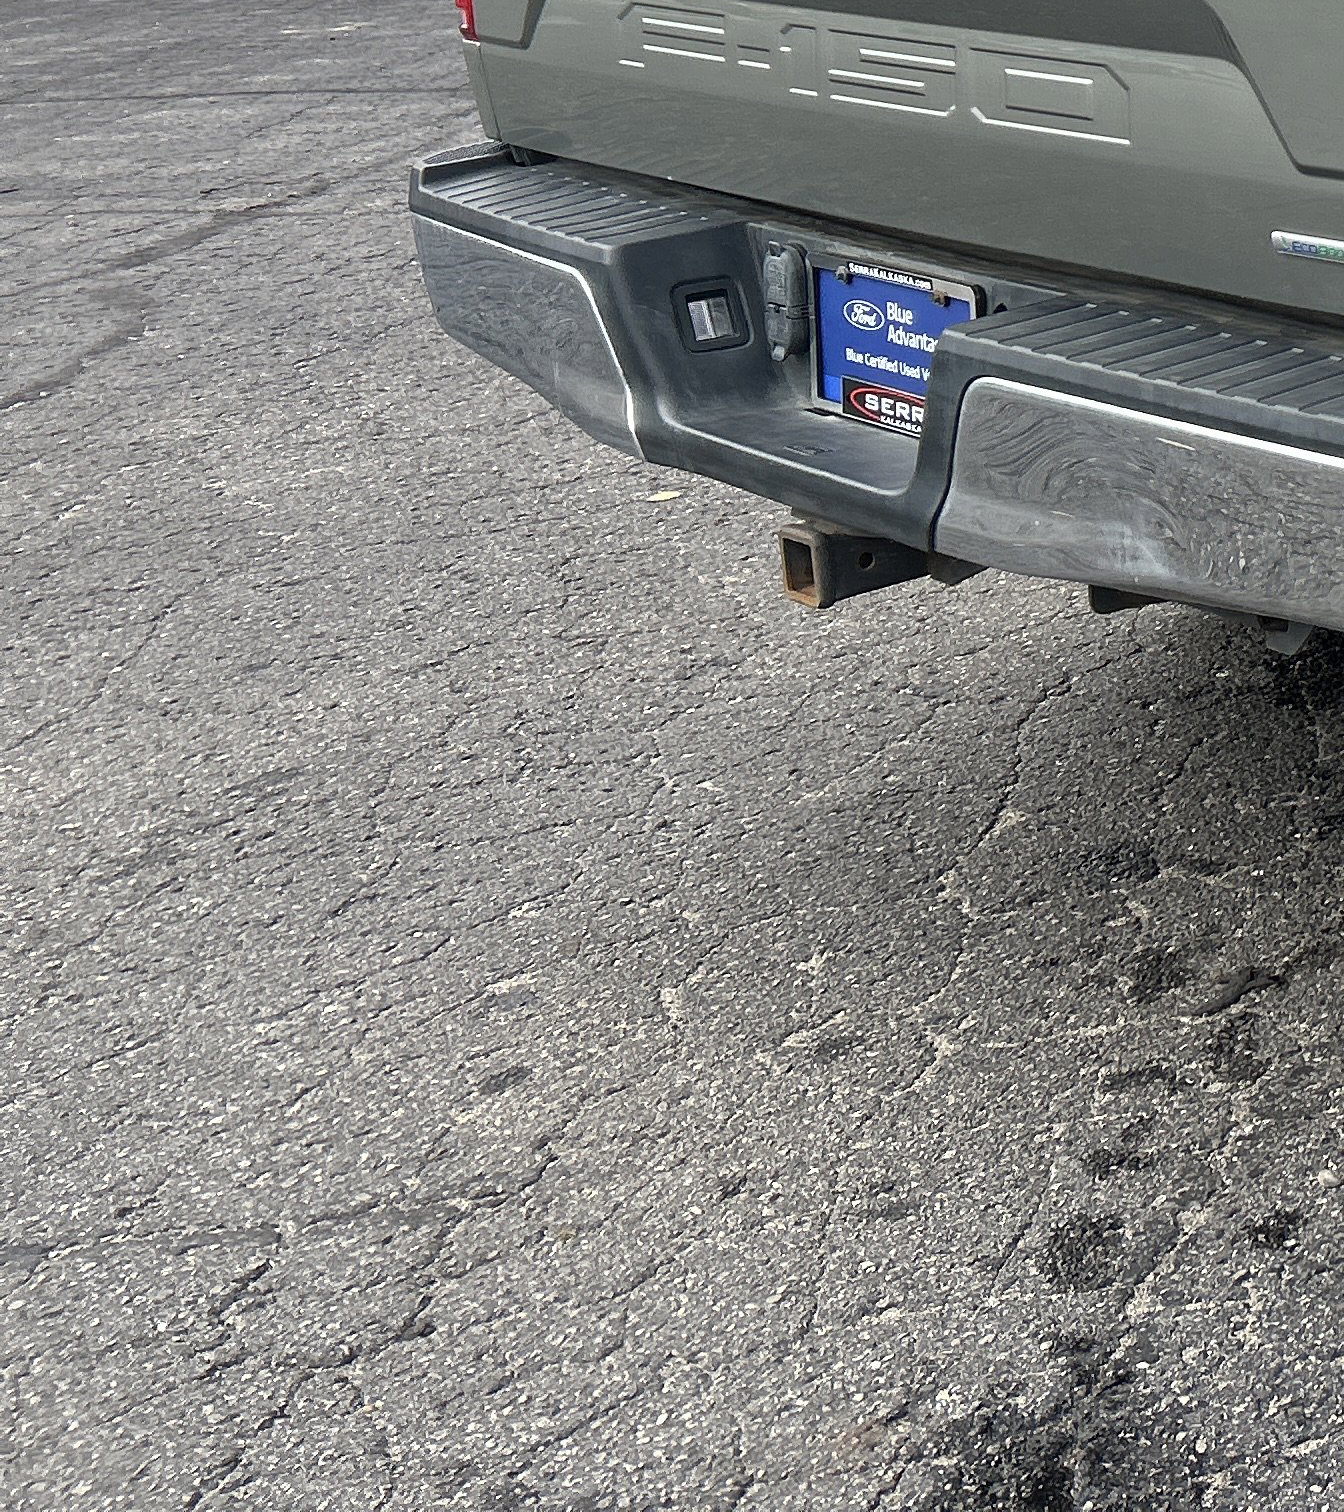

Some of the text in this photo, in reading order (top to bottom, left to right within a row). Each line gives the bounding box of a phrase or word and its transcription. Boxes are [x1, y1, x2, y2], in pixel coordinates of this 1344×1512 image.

[618, 2, 1131, 145] F-150
[851, 301, 913, 326] Ford Blue
[845, 347, 864, 364] Blue
[864, 352, 898, 373] Certified
[899, 361, 920, 379] Used
[864, 393, 925, 423] SERR
